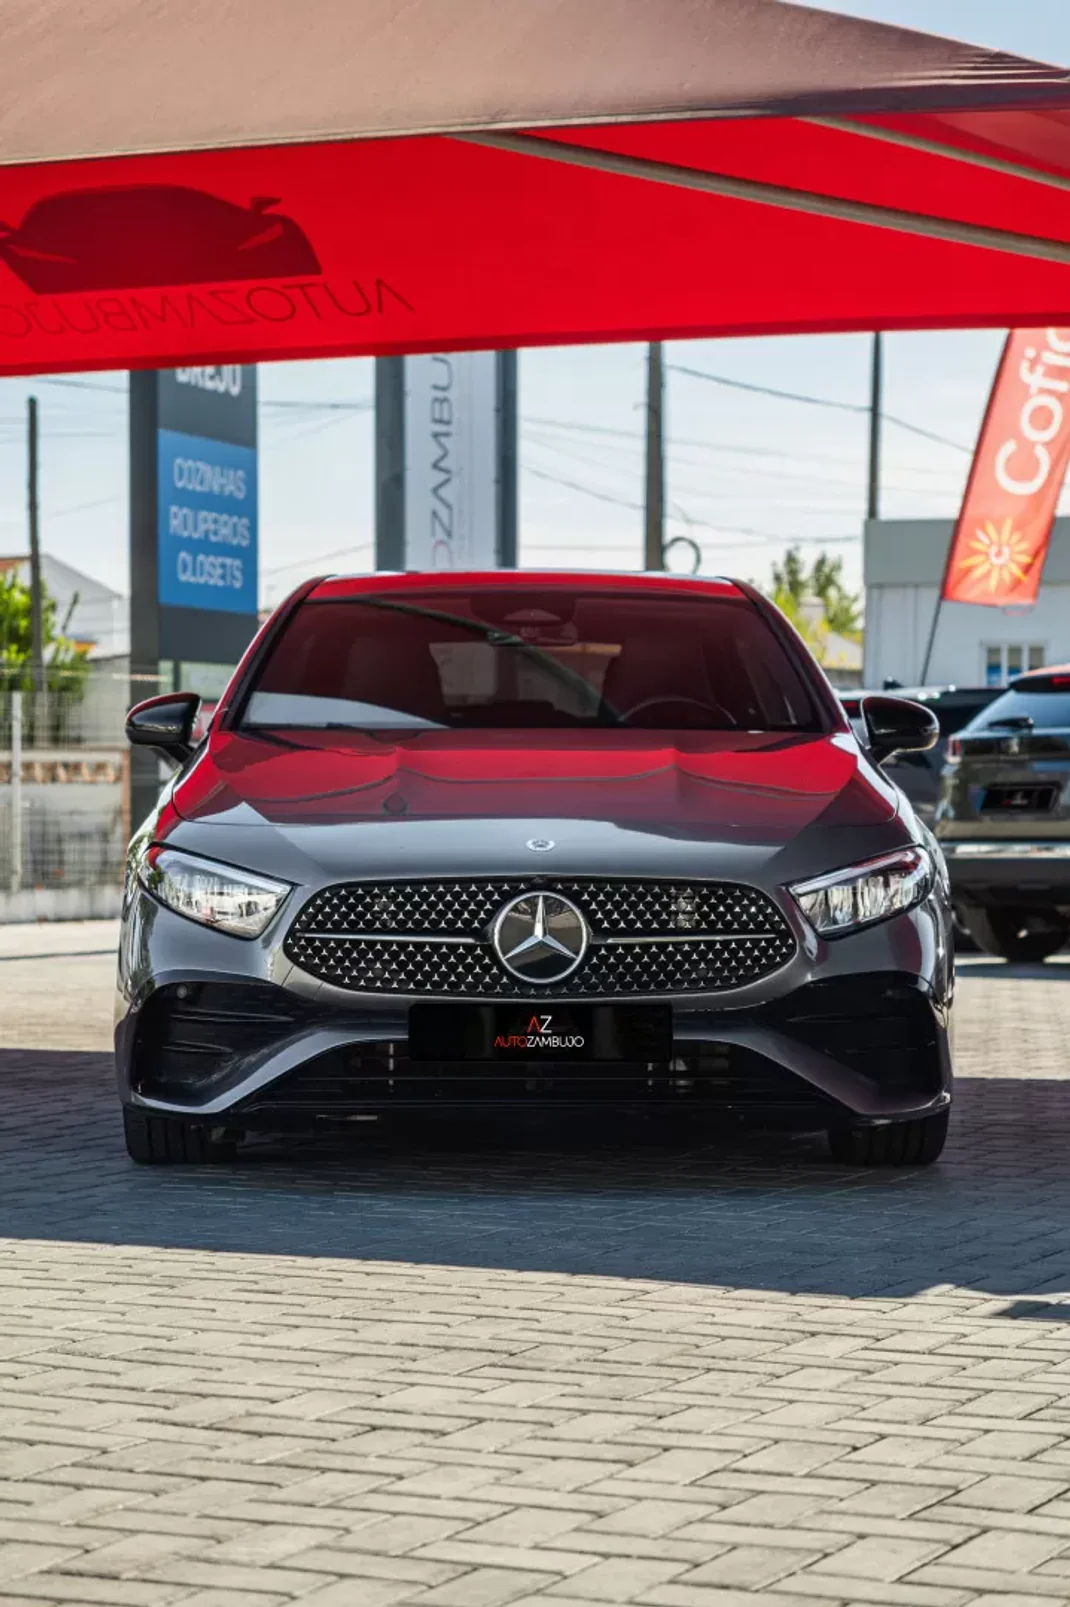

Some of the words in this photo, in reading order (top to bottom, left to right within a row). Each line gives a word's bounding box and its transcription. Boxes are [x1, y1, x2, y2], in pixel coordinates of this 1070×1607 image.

[173, 457, 247, 500] COZINHAS
[177, 551, 244, 589] CLOSETS
[527, 1015, 553, 1033] AZ
[494, 1035, 585, 1048] AUTOZAMBUJO
